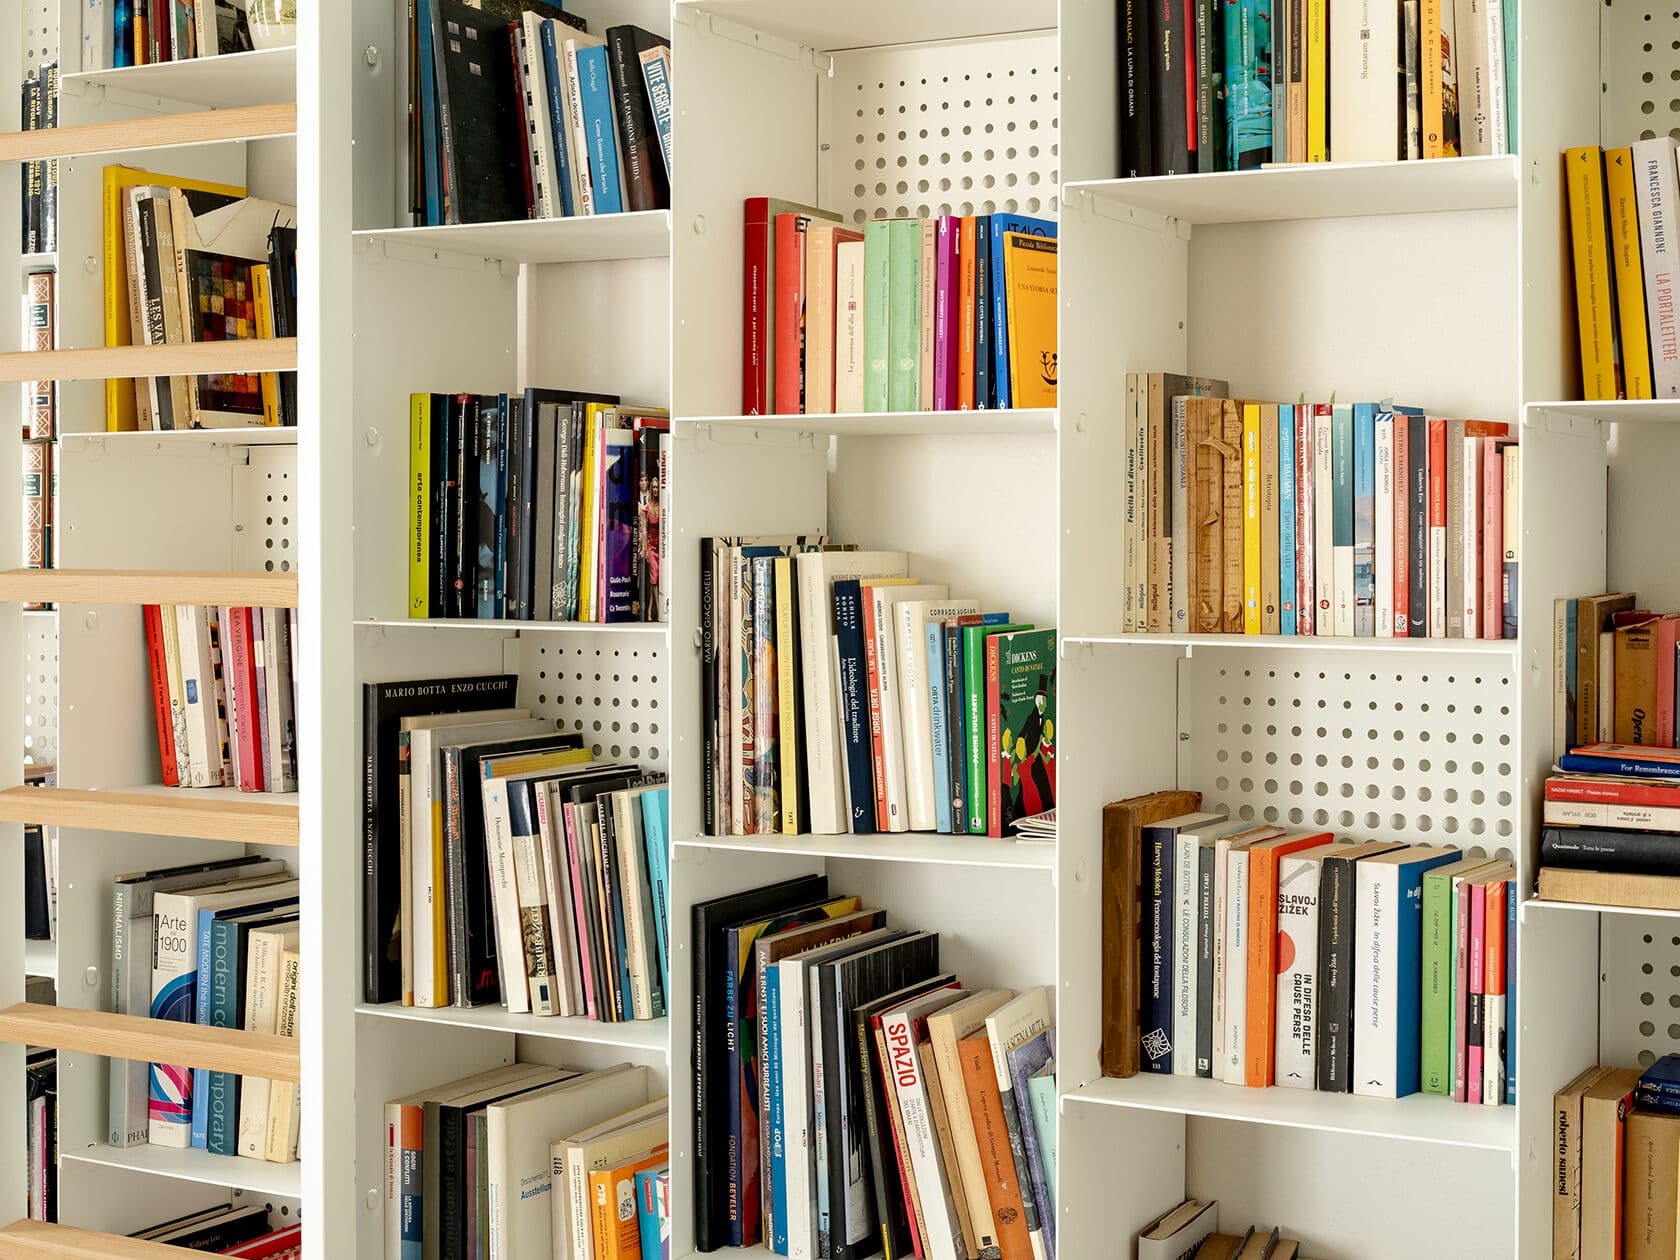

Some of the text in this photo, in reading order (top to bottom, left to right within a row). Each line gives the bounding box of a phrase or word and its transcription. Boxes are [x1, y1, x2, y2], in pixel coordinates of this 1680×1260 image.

[616, 38, 627, 87] Caroline Bernard
[1127, 47, 1133, 56] LA
[1197, 4, 1208, 78] margaret mazzantini
[30, 88, 37, 98] LA
[46, 69, 54, 119] DELL'EUROPA
[569, 76, 581, 129] Artista designer
[589, 73, 597, 93] Chagall
[646, 61, 670, 125] VITE SEGRETE
[594, 119, 602, 137] Come
[622, 92, 640, 181] LA PASSIONE DI FRIDA
[1201, 115, 1209, 123] di
[1201, 124, 1209, 145] zinco
[596, 138, 604, 162] fiamma
[33, 180, 41, 196] 1917
[600, 173, 608, 194] brucia
[1647, 160, 1666, 254] FRANCESCA GIANNONE
[143, 210, 151, 247] Flammarion
[1619, 197, 1628, 218] Zeruya
[127, 206, 139, 275] Rachel Whiteread
[176, 249, 185, 273] KLEE
[1622, 243, 1631, 268] Stupore
[150, 297, 162, 321] LES
[1656, 273, 1678, 362] LA PORTALETTERE
[559, 419, 569, 492] Georges Didi-Huberman
[1179, 434, 1188, 489] CONTEMPORANEA
[1281, 427, 1292, 500] zygmunt BAUMAN
[1264, 474, 1273, 511] Retrotopia
[414, 472, 425, 563] arte contemporanea
[558, 494, 568, 553] Immagini malgrado
[703, 570, 712, 664] MARIO GIACOMELLI
[834, 596, 842, 621] OLIVA
[841, 596, 849, 626] BONITO
[848, 595, 856, 630] ACHILLE
[234, 610, 245, 667] LEA VERGINE
[1011, 650, 1037, 665] DICKENS
[989, 645, 998, 682] DICKENS
[385, 680, 508, 698] MARIO BOTTA ENZO CUCCHI
[847, 657, 861, 744] L'ideologia del traditore
[870, 688, 881, 735] JORGE ORTA
[931, 686, 942, 757] ORTA drinkwater
[1631, 708, 1646, 745] Opera
[1620, 763, 1680, 775] For Remembrance
[366, 756, 374, 876] MARIO BOTTA ENZO CUCCHI
[495, 816, 506, 850] Donazione
[600, 833, 610, 869] DUCHAMP
[1152, 842, 1163, 896] Harvey Molotch
[1182, 841, 1191, 896] ALAIN DE BOTTON
[1552, 842, 1580, 850] Quasimodo
[159, 914, 188, 932] Arte
[1278, 894, 1317, 905] SLAVOJ
[1373, 907, 1382, 927] ŽIŽEK
[114, 893, 124, 960] MINIMALISMO
[159, 935, 188, 954] 1900
[1151, 899, 1163, 998] Fenomenologia del tostapane
[200, 930, 210, 1002] TATE MODERN the
[213, 925, 230, 1005] modern
[289, 960, 299, 991] origini
[1180, 909, 1190, 1017] LE CONSOLAZIONI DELLA FILOSOFIA
[1370, 931, 1381, 1028] In difesa delle cause perse
[1432, 960, 1440, 994] GRODDECK
[727, 971, 735, 1052] FARBE ZU LICHT
[1293, 973, 1303, 1039] CAUSE PERSE
[1302, 974, 1312, 1055] IN DIFESA DELLE
[759, 951, 771, 1112] MAX ERNST SUOI AMICI SURREALISTI
[889, 1023, 917, 1087] SPAZIO
[815, 1063, 824, 1088] Balkan
[192, 1131, 206, 1141] TATE
[982, 1112, 998, 1159] grafica Giorgio
[1558, 1110, 1569, 1197] roberto sanesi
[403, 1155, 411, 1185] CONFLITTI
[728, 1135, 738, 1221] FONDATION BEYELER
